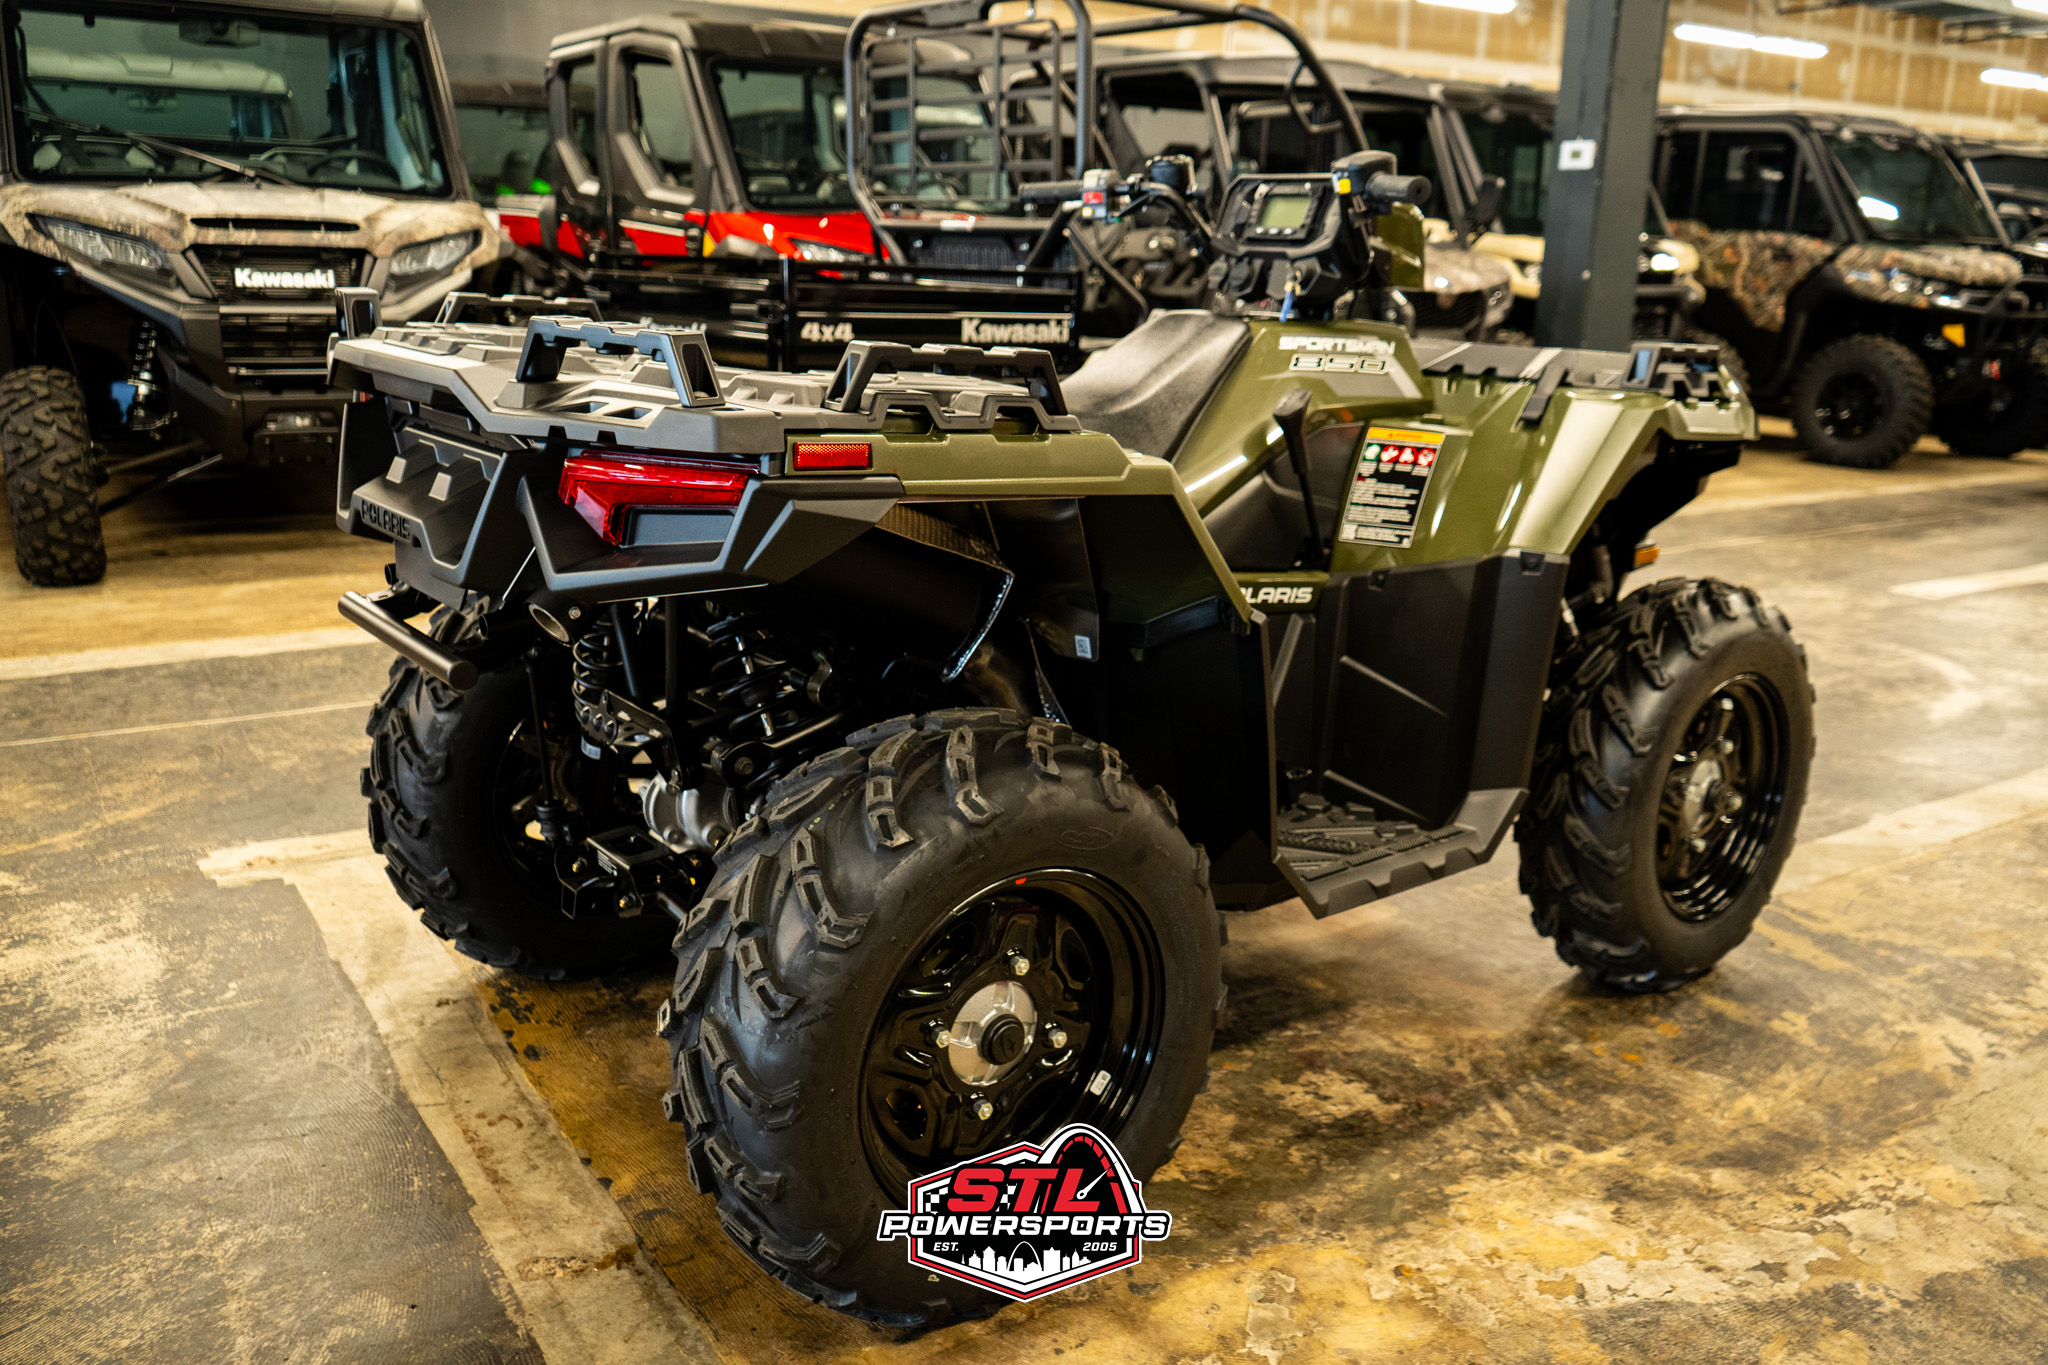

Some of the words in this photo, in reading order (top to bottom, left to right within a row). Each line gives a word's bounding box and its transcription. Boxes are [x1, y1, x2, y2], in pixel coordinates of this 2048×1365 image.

[234, 267, 335, 289] Kawasaki
[801, 321, 854, 343] 4x4
[961, 318, 1070, 344] Kawasaki
[1279, 335, 1396, 356] SPORTSMAN
[1289, 353, 1390, 375] 850
[361, 499, 411, 540] POLARIS
